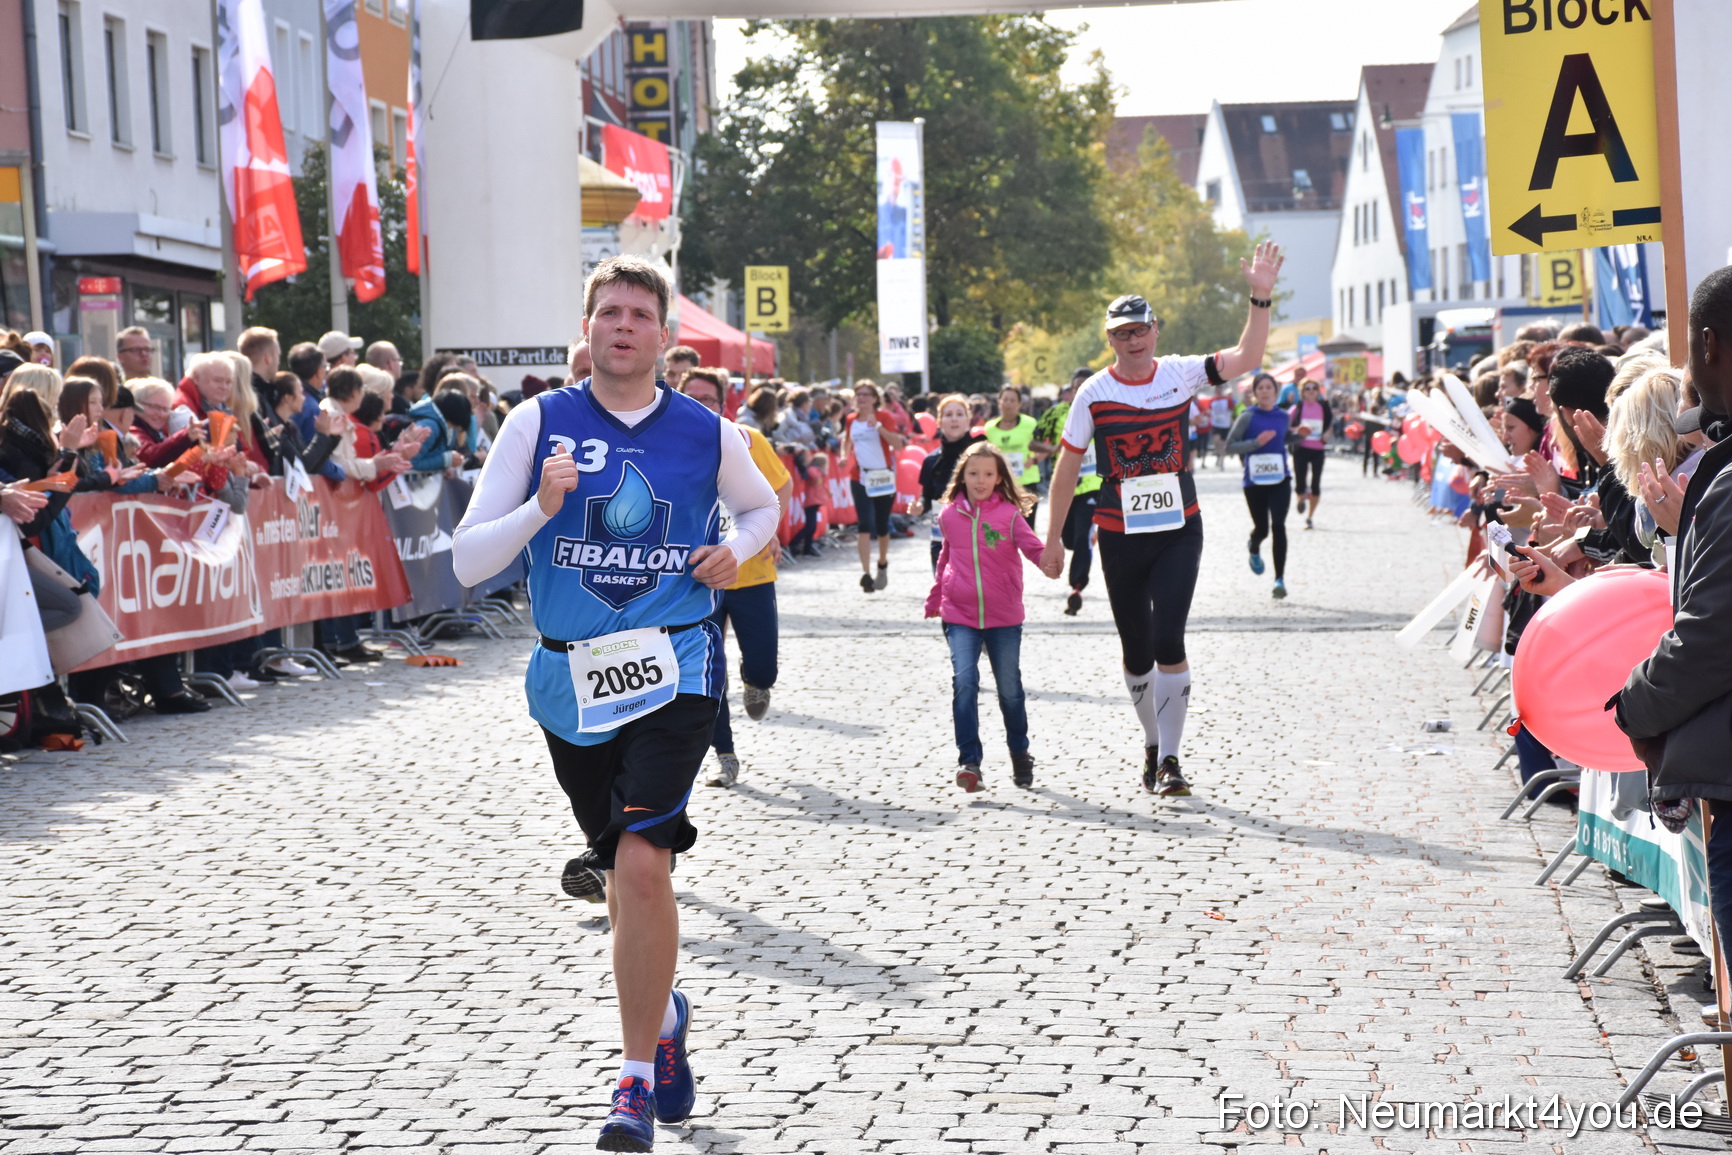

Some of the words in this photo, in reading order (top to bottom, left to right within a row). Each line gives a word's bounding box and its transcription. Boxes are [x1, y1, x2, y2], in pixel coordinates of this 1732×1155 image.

[1503, 0, 1652, 35] Block
[1528, 53, 1639, 191] A
[750, 269, 783, 281] Block
[1551, 259, 1575, 290] B
[757, 286, 777, 316] B
[1034, 355, 1047, 374] C
[1255, 463, 1279, 473] 2904
[1131, 491, 1173, 511] 2790
[556, 541, 689, 571] FIBALON
[592, 574, 648, 586] BASKETS
[1464, 607, 1479, 632] swn
[602, 639, 639, 654] BOCK
[586, 655, 663, 699] 2085
[612, 698, 646, 715] Jürgen
